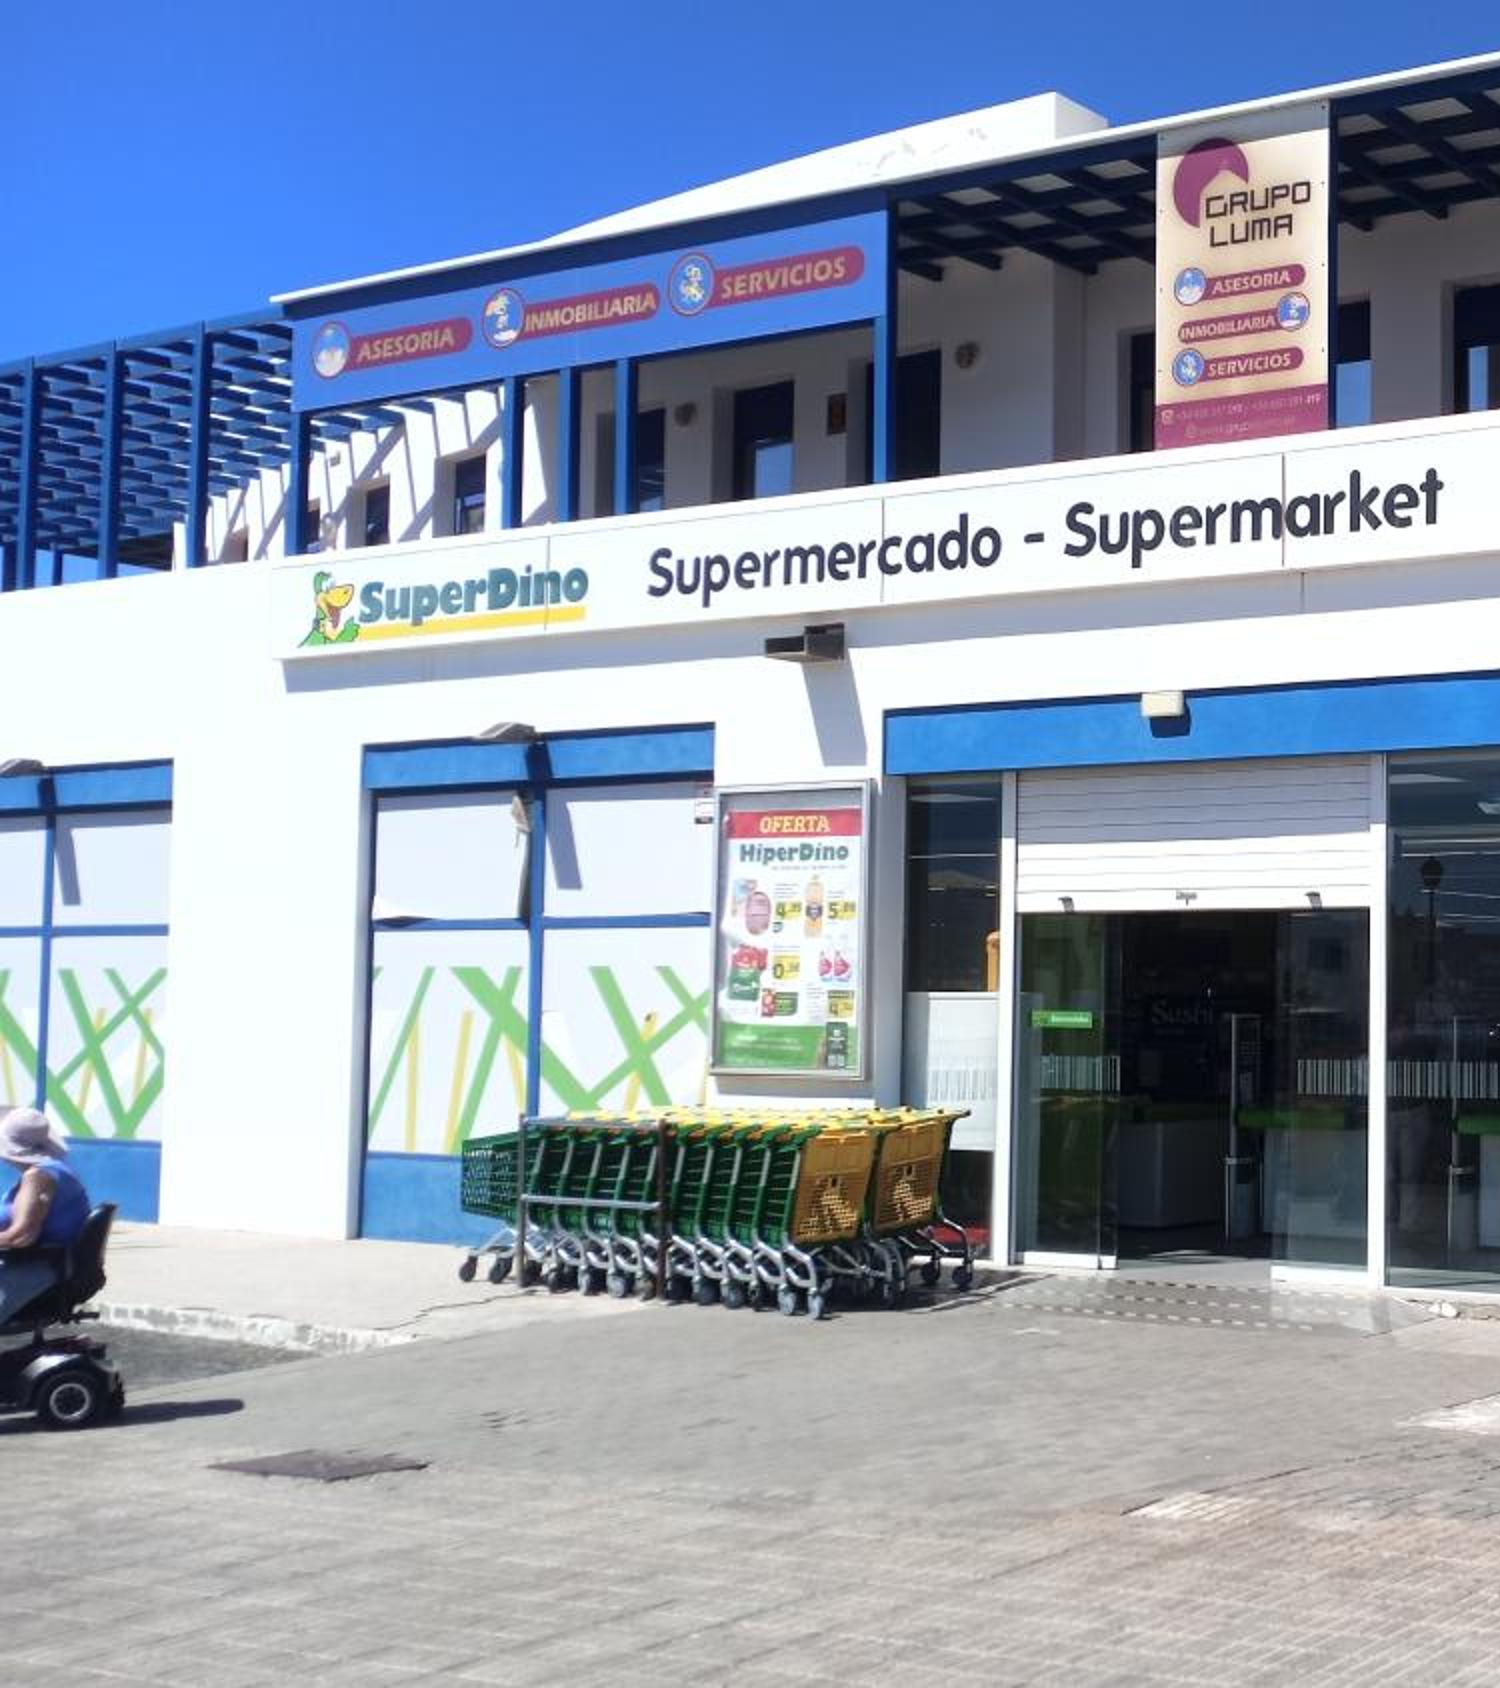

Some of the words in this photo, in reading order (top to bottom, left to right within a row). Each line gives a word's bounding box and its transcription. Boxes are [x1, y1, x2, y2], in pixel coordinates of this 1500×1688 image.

[1206, 181, 1312, 219] GRUPO
[1209, 214, 1293, 248] LUMA
[720, 256, 847, 300] SERVICIOS
[1211, 270, 1292, 295] ASESORIA
[523, 291, 658, 333] INMOBILIARIA
[1181, 315, 1277, 341] INMOBILIARIA
[356, 326, 456, 363] ASESORIA
[1207, 352, 1292, 378] SERVICIOS
[646, 513, 1003, 608] Supermercado
[1063, 467, 1445, 569] Supermarket
[359, 563, 589, 626] SuperDino
[759, 815, 832, 834] OFERTA
[739, 841, 850, 867] HiperDino
